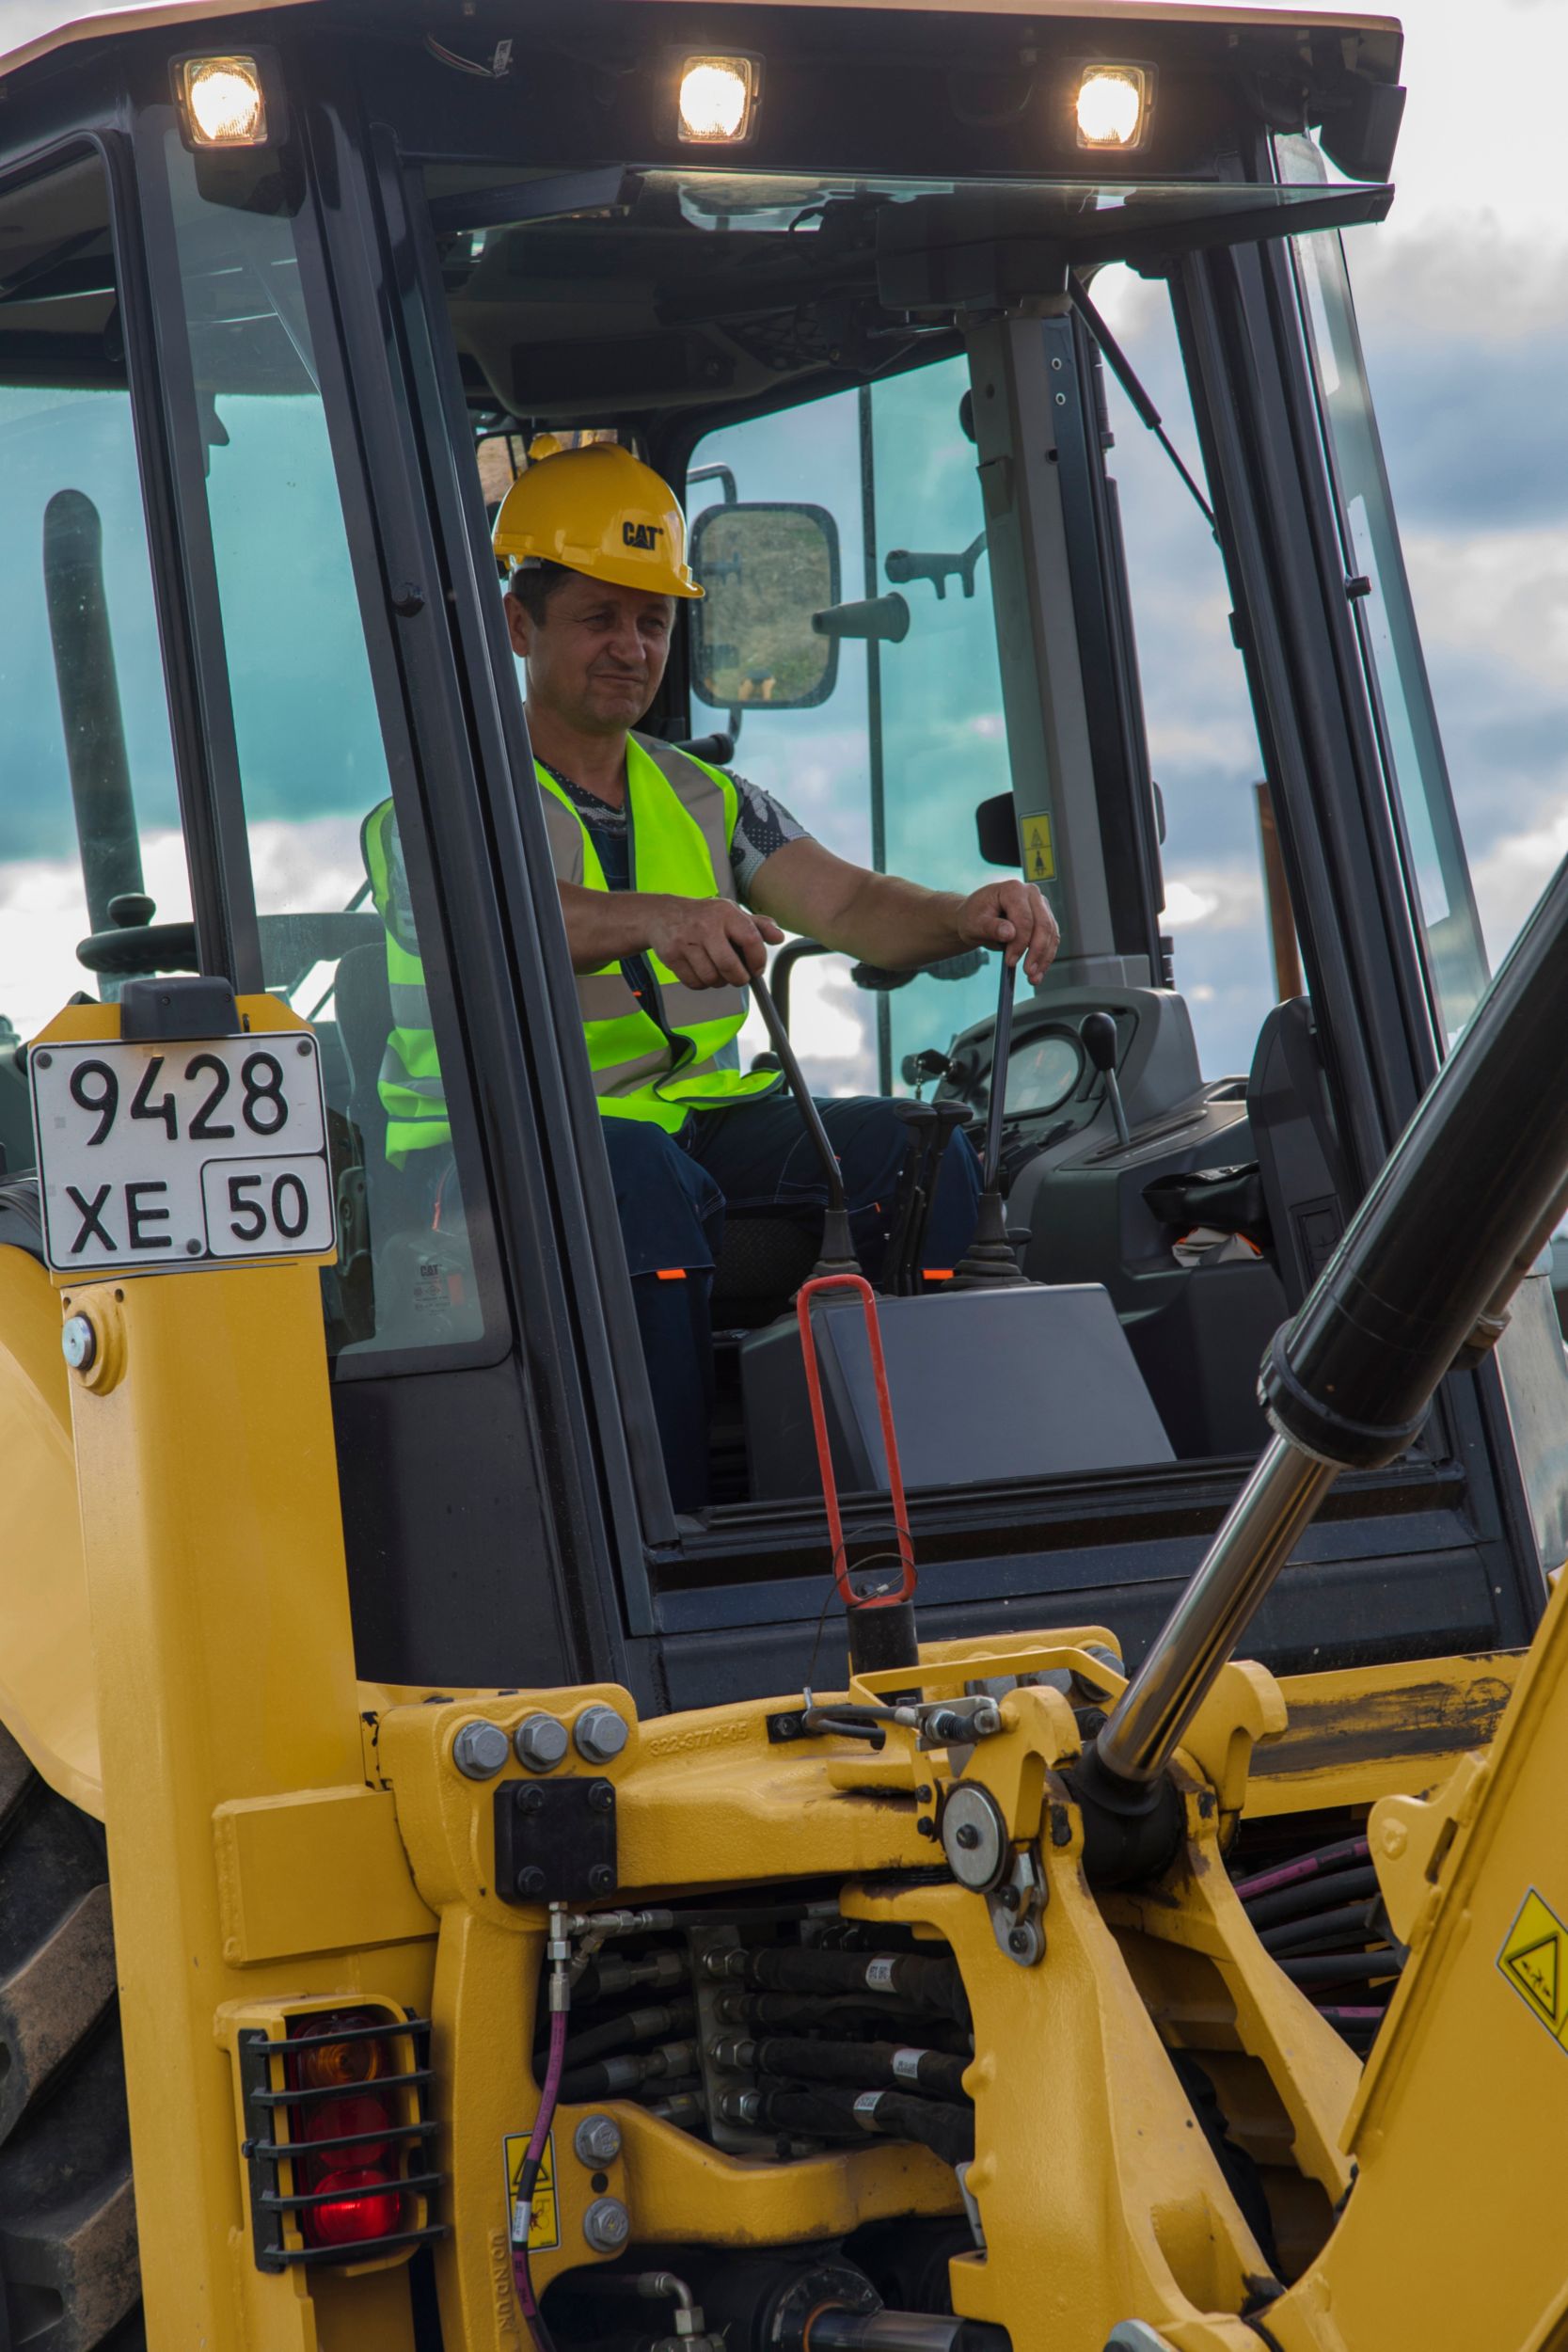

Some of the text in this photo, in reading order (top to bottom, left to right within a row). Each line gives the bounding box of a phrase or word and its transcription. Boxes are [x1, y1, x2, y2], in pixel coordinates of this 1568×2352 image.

[623, 521, 660, 550] CAT
[70, 1051, 289, 1146] 9428
[228, 1173, 309, 1241] 50
